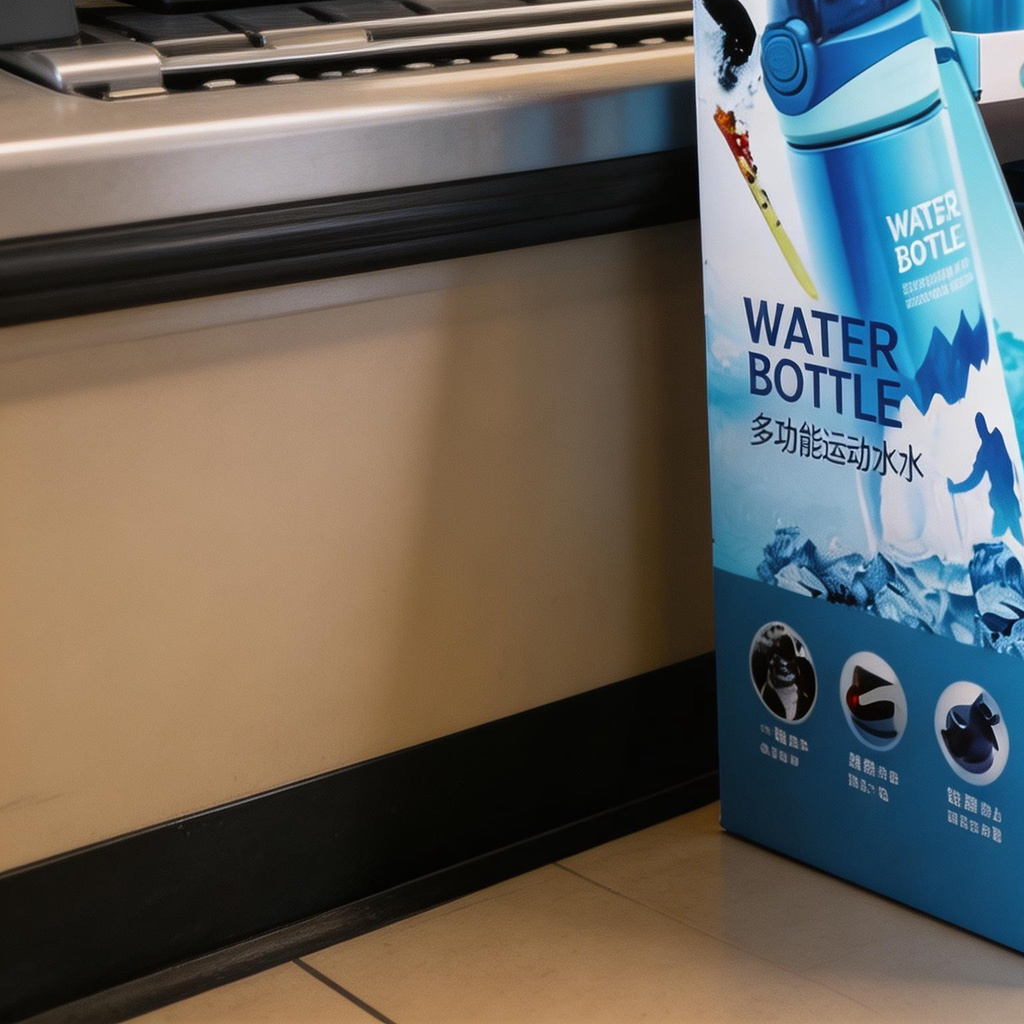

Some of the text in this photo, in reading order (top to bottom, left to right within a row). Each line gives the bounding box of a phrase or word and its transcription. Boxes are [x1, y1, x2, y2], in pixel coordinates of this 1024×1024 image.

[886, 190, 961, 242] WATER
[894, 224, 966, 273] BOTLE
[743, 297, 899, 372] WATER
[748, 351, 902, 429] BOTTLE
[750, 412, 924, 483] 多功能运动水水
